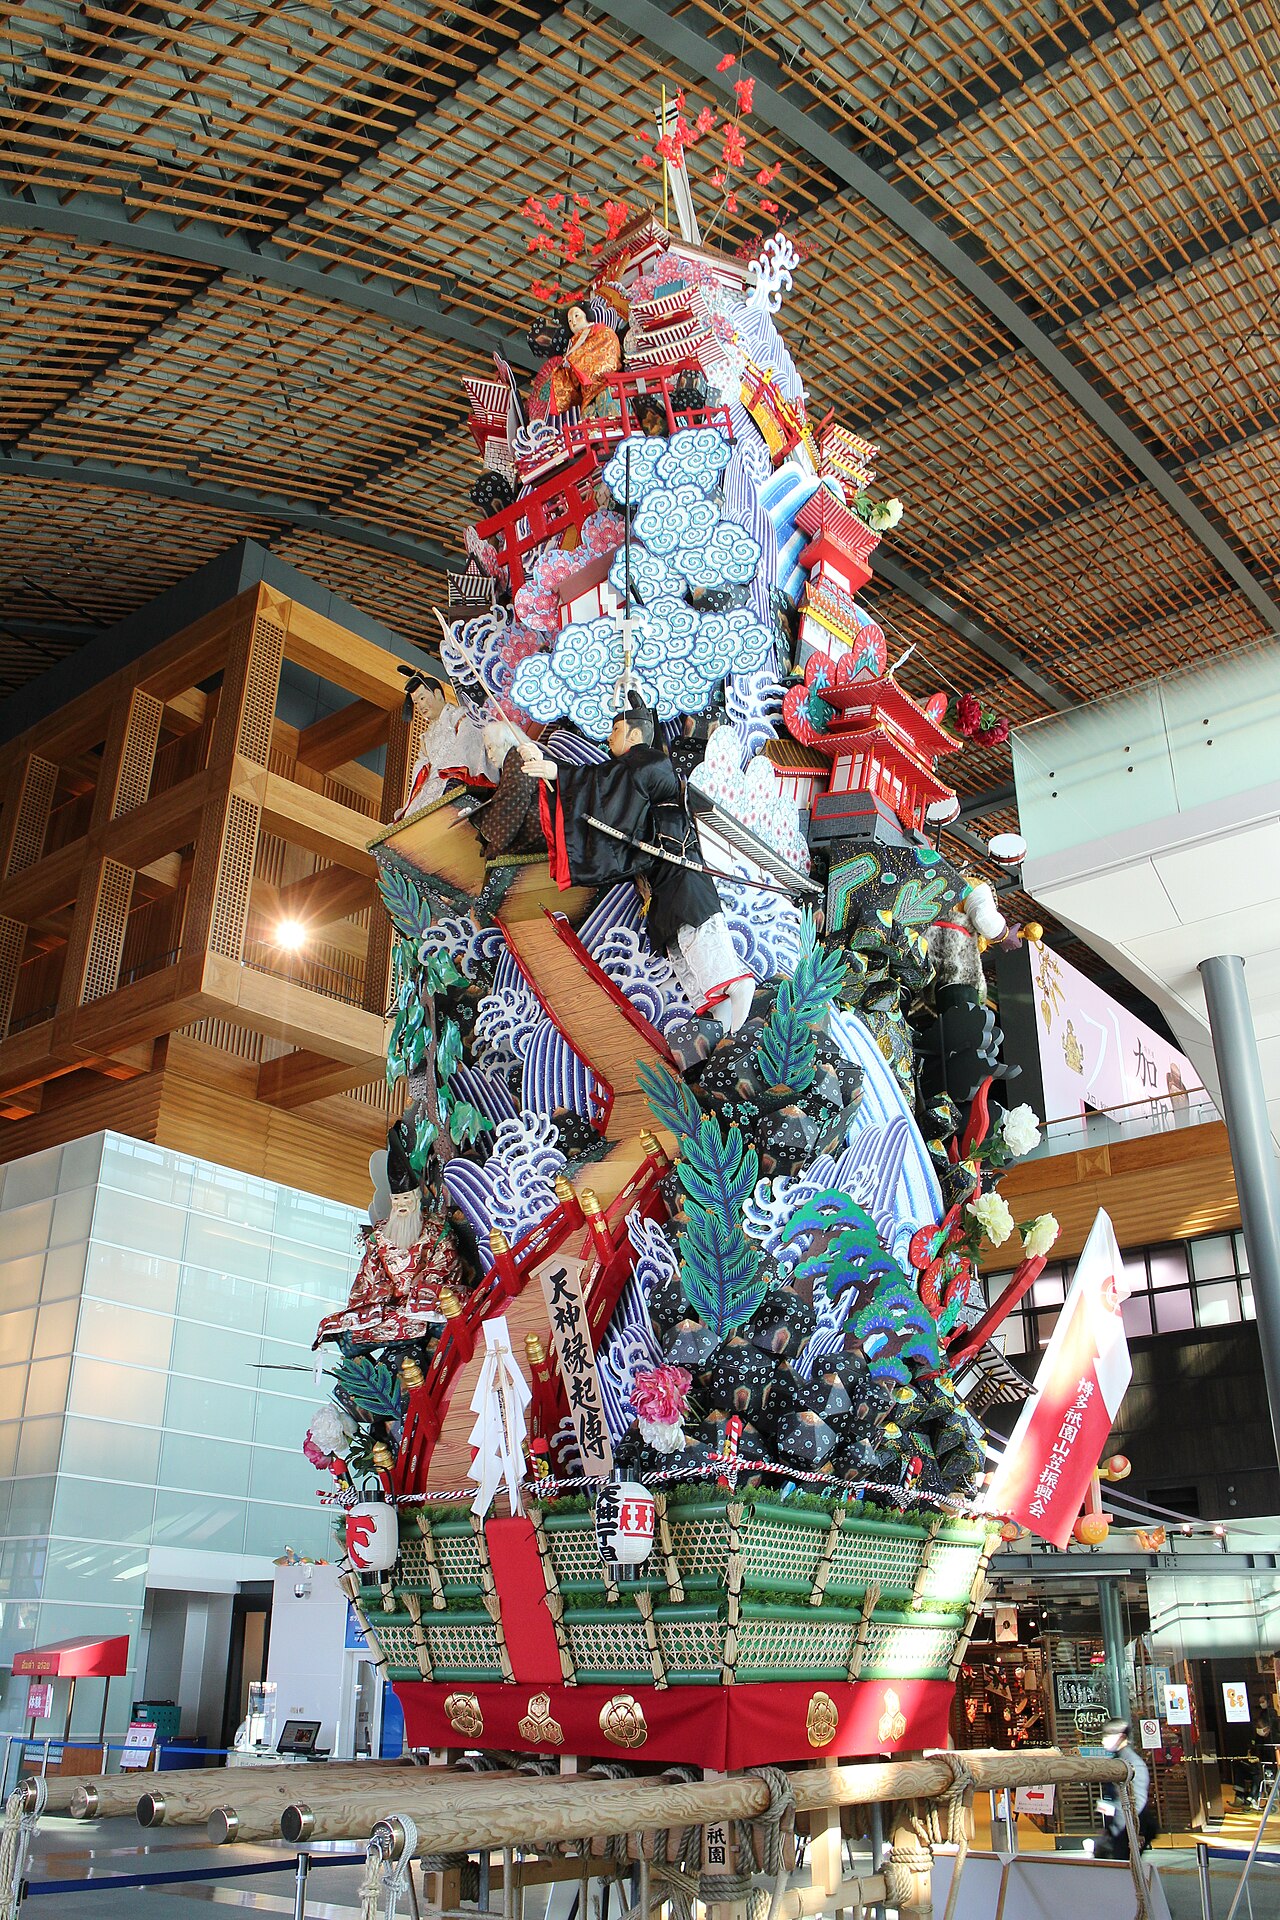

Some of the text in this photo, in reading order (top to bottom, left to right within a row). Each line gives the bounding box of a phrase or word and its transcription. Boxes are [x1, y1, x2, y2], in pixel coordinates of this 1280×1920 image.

[1028, 1376, 1095, 1520] 博多祇園山笠振興会
[596, 1484, 622, 1562] 天神一丁目
[707, 1821, 727, 1866] 祇園
